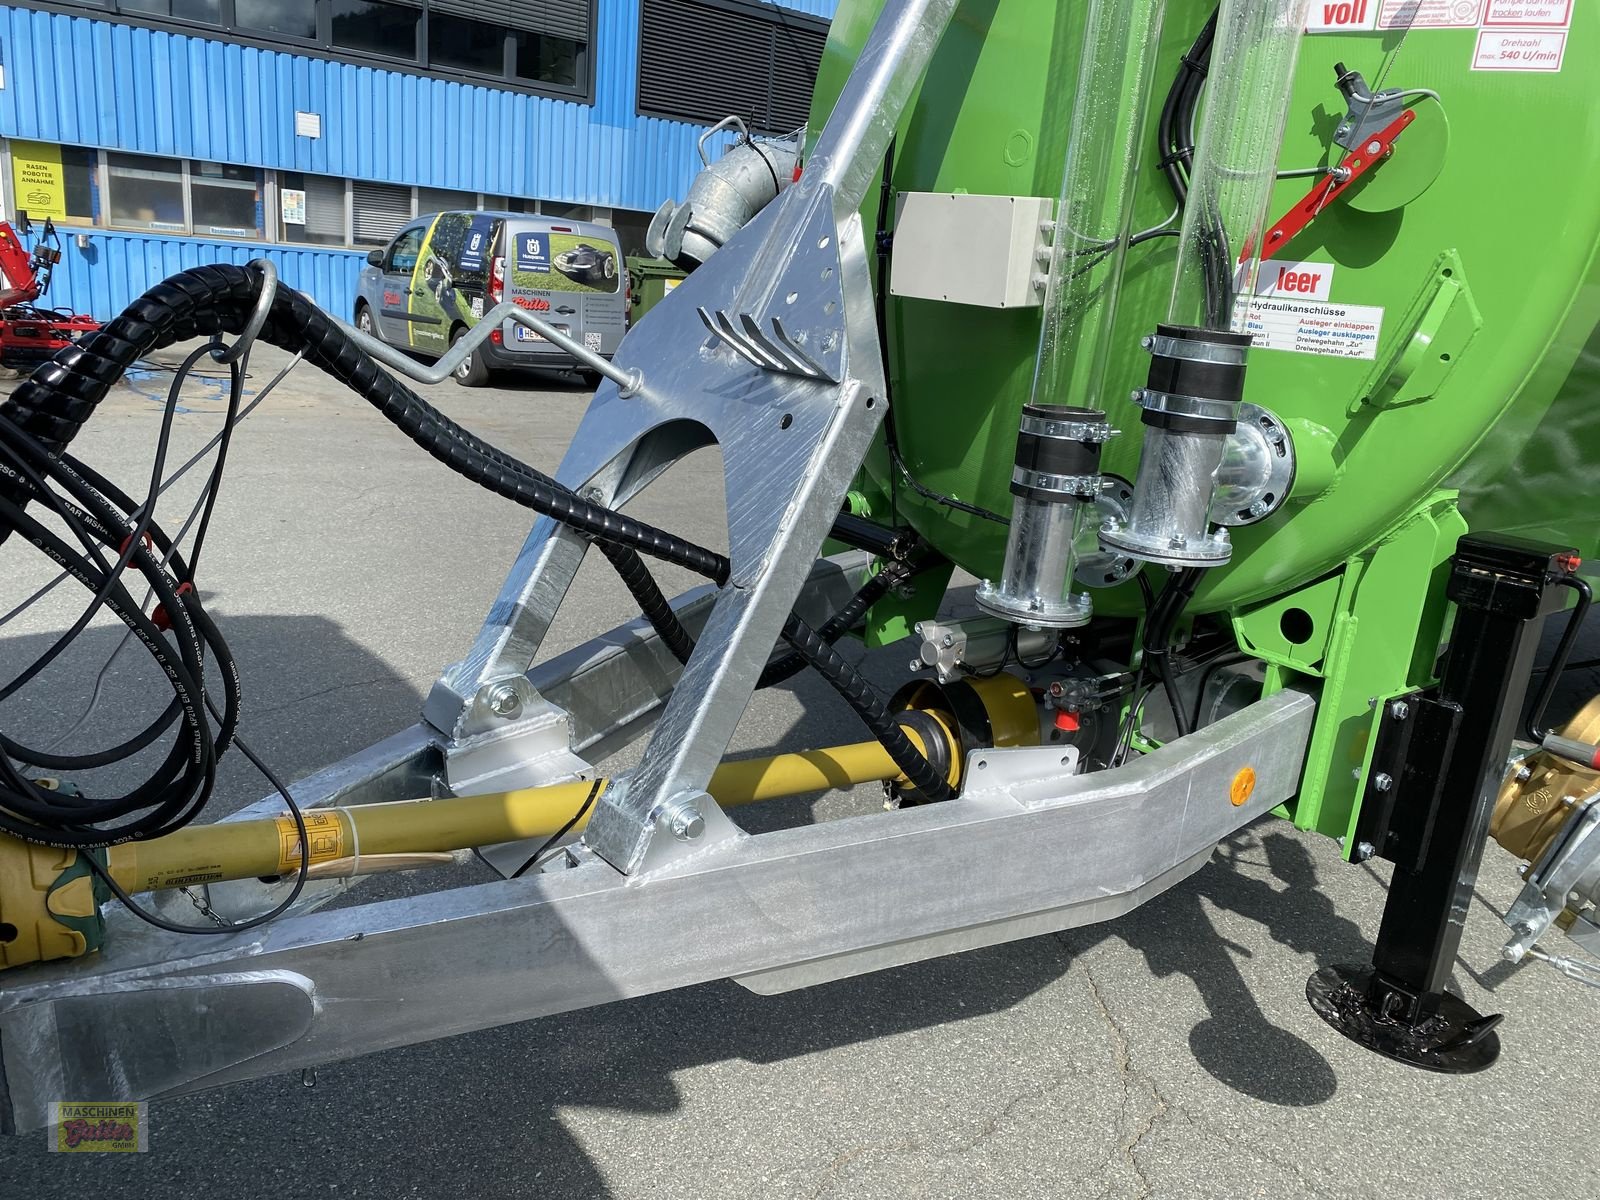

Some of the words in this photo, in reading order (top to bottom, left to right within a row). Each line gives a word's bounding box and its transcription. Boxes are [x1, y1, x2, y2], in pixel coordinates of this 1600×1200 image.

[1324, 0, 1368, 25] voll
[1492, 8, 1523, 17] trocken
[1524, 8, 1551, 17] laufen
[1501, 39, 1541, 47] Drehzahl
[1500, 50, 1520, 60] 540
[1522, 50, 1557, 61] U/min
[26, 163, 48, 171] RASEN
[22, 170, 53, 179] ROBOTER
[21, 177, 55, 186] ANNAHME
[1276, 266, 1321, 294] leer
[511, 289, 551, 297] MASCHINEN
[1251, 300, 1346, 317] Hydraulikanschlüsse
[1249, 313, 1261, 321] Rot
[1300, 318, 1333, 328] Ausleger
[1333, 321, 1375, 331] einklappen
[525, 330, 534, 338] HE
[1247, 321, 1264, 330] Blau
[1298, 327, 1331, 337] Ausleger
[1331, 331, 1375, 341] ausklappen
[1296, 336, 1345, 346] Dreiwegehahn
[1295, 344, 1344, 355] Dreiwegehahn
